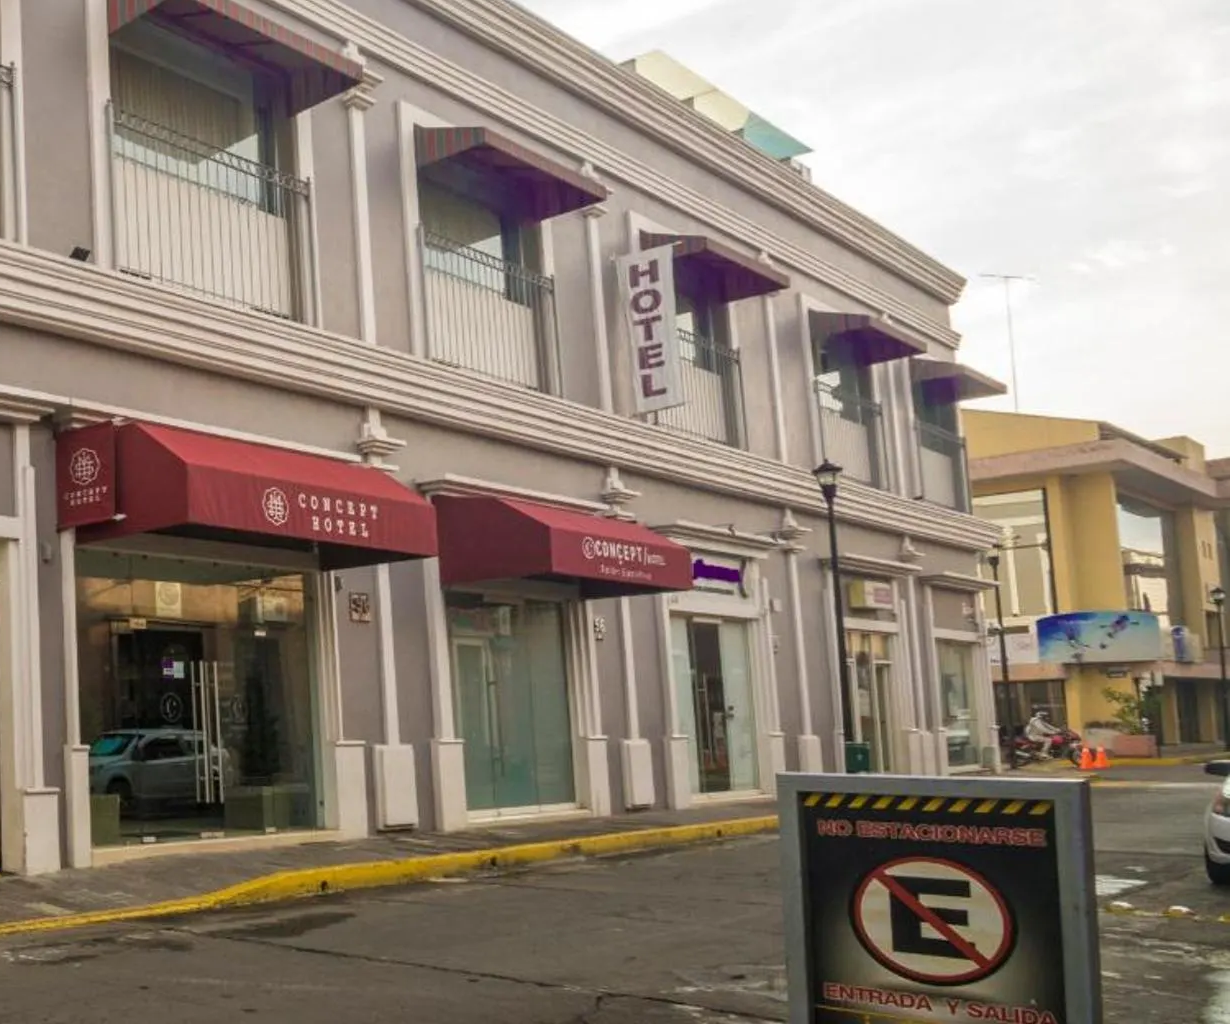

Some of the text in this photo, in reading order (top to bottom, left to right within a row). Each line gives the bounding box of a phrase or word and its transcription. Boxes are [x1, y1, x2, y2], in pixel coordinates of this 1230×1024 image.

[628, 258, 667, 399] HOTEL
[297, 491, 378, 520] CONCEPT
[311, 516, 369, 538] HOTEL
[817, 819, 1048, 848] NO ESTACIONARSE
[824, 981, 1059, 1024] ENTRADA Y SALIDA
